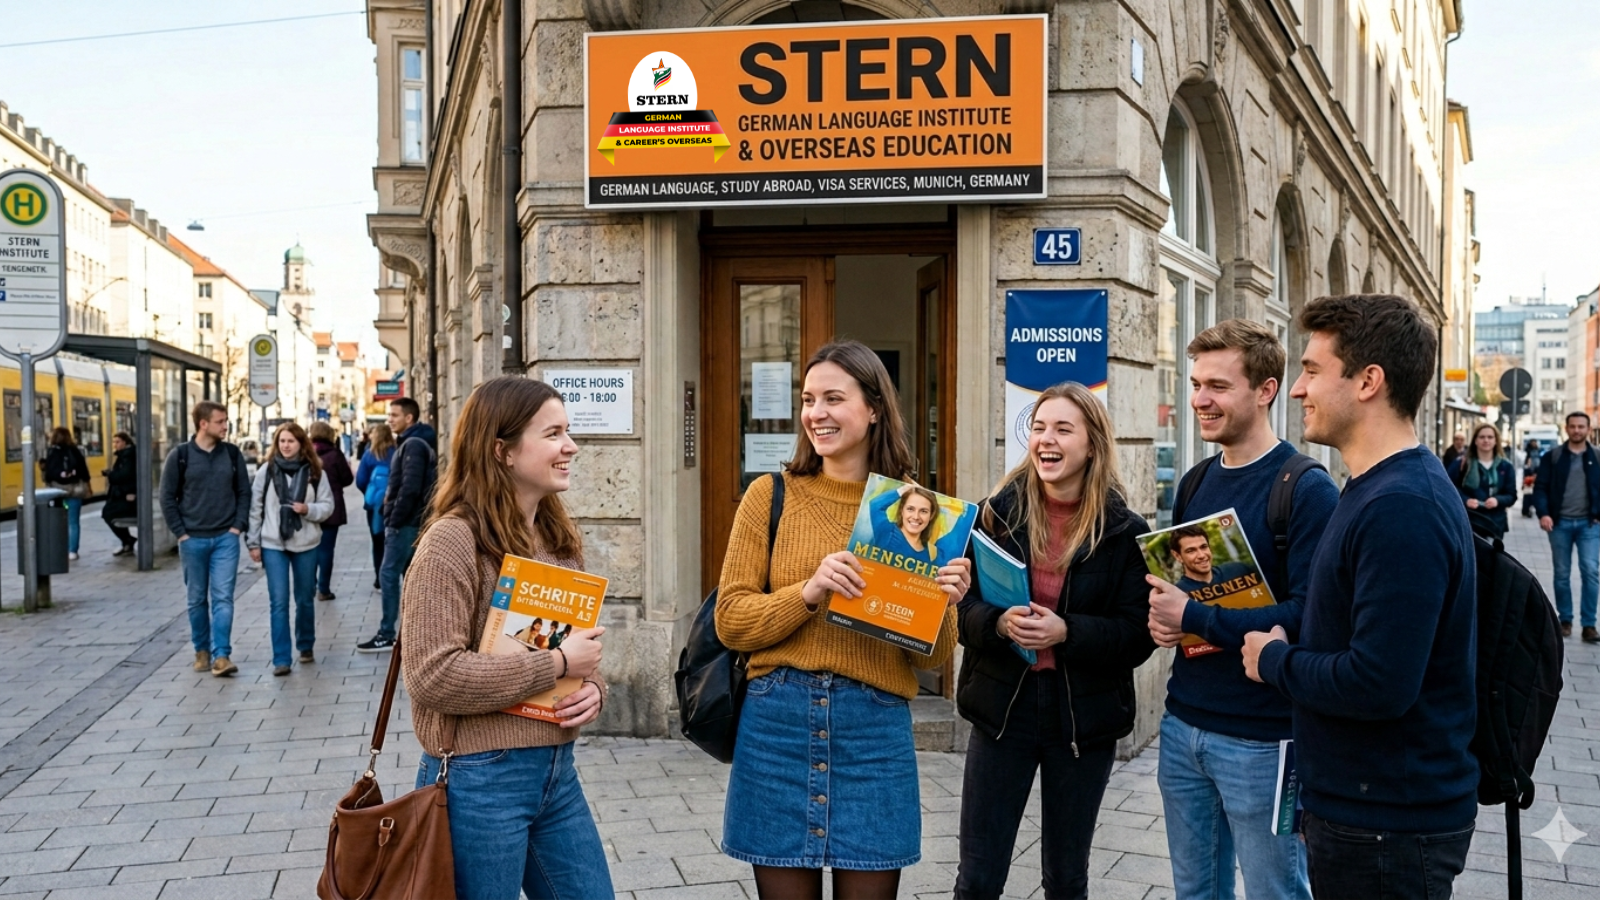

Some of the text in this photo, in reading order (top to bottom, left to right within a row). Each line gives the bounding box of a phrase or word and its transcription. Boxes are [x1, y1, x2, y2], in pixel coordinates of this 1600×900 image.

[737, 33, 1012, 105] STERN
[636, 94, 689, 106] STERN
[644, 113, 682, 122] GERMAN
[738, 107, 1012, 132] GERMAN LANGUAGE INSTITUTE
[618, 124, 711, 134] LANGUAGE INSTITUTE
[623, 138, 666, 146] CAREER'S
[667, 137, 713, 145] OVERSEAS
[738, 132, 1012, 162] & OVERSEAS EDUCATION
[600, 173, 1030, 197] GERMAN LANGUAGE, STUDY ABROAD, VISA SERVICES, MUNICH, GERMANY
[14, 192, 34, 216] H
[8, 236, 40, 246] STERN
[1041, 233, 1073, 260] 45
[1010, 326, 1103, 343] ADMISSIONS
[1036, 347, 1077, 363] OPEN
[552, 377, 624, 389] OFFICE HOURS
[590, 392, 617, 403] 18:00
[853, 541, 939, 579] MENSCHE
[518, 581, 597, 611] SCHRITTE
